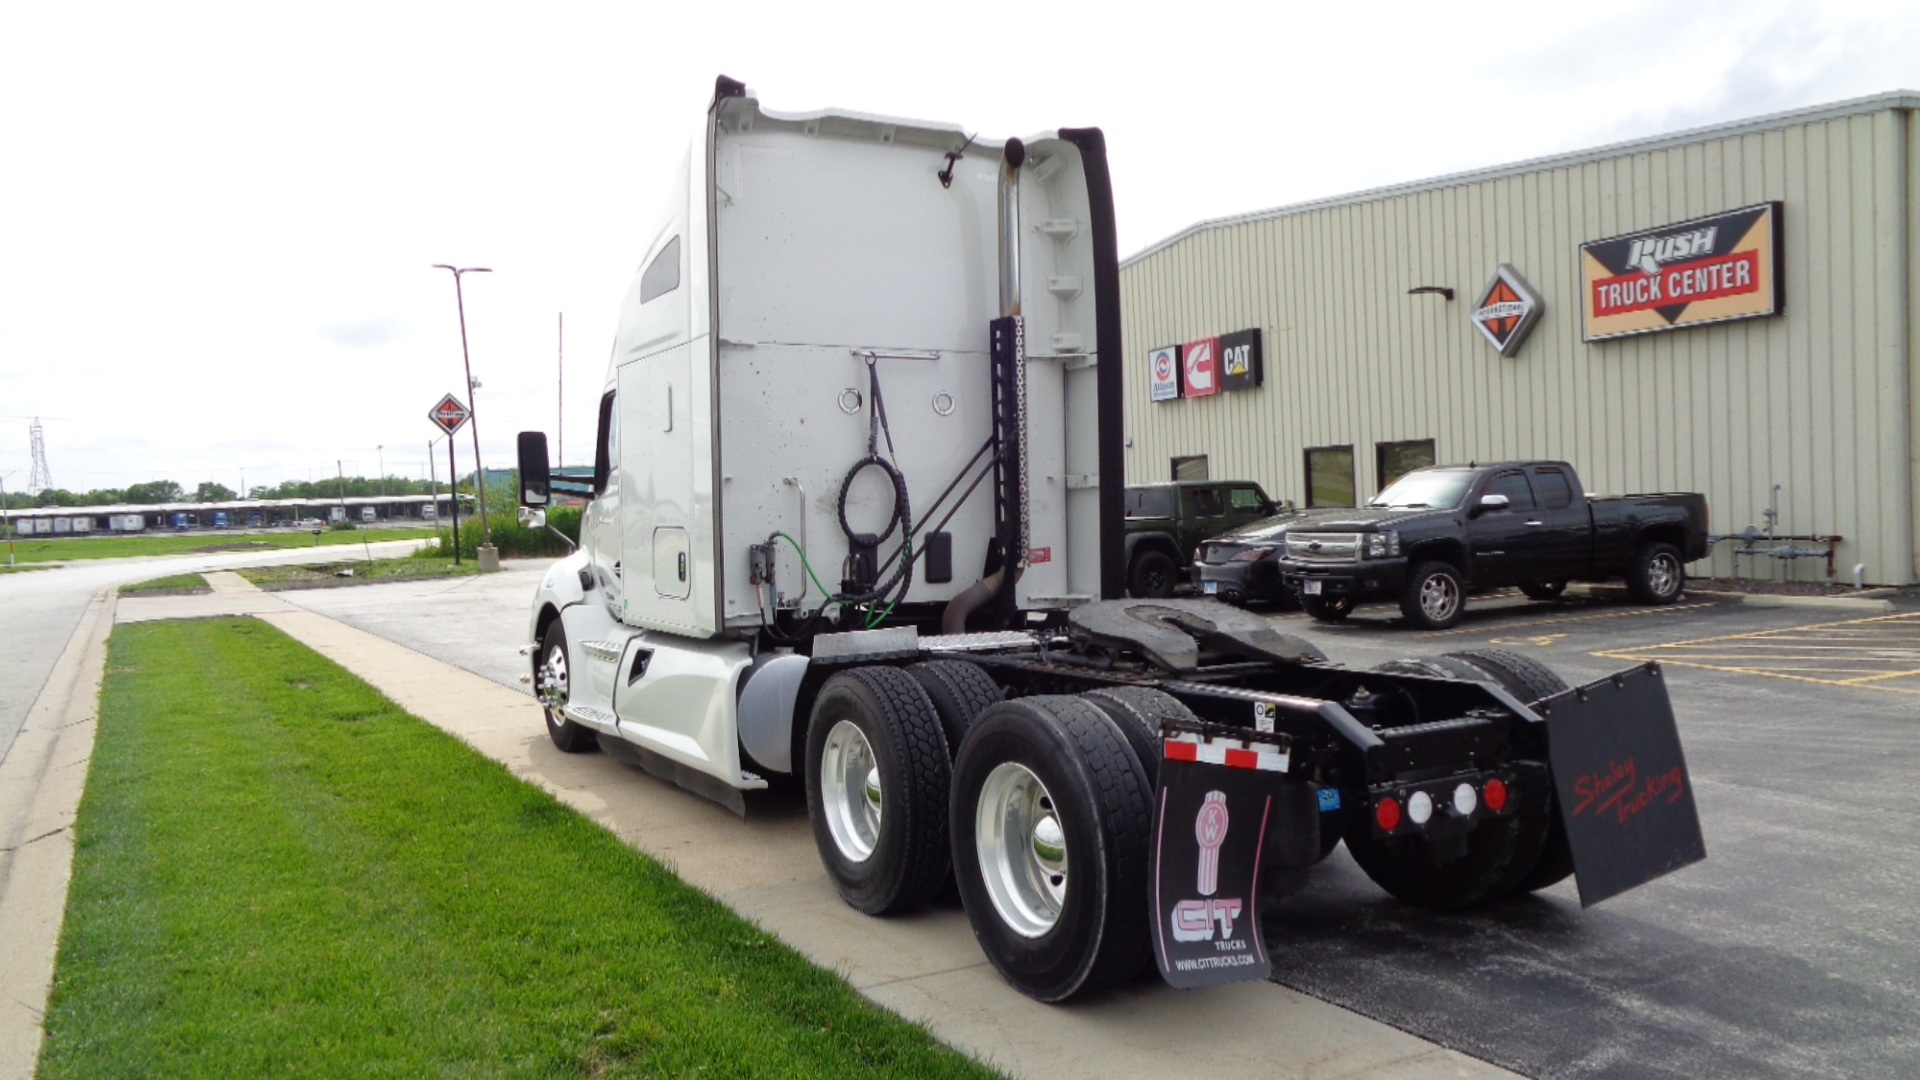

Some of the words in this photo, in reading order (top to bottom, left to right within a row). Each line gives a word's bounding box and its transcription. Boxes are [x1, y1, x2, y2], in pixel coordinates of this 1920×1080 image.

[1598, 275, 1662, 309] TRUCK
[1668, 260, 1751, 296] CENTER
[1478, 303, 1524, 316] INTERNATIONAL
[1224, 345, 1250, 376] CAT
[1606, 765, 1684, 824] Trucking
[1208, 809, 1218, 825] K
[1205, 824, 1219, 841] W
[1171, 898, 1242, 942] CIT
[1215, 940, 1247, 951] TRUCKS
[1175, 953, 1255, 971] WWW.CITTRUCKS.COM
